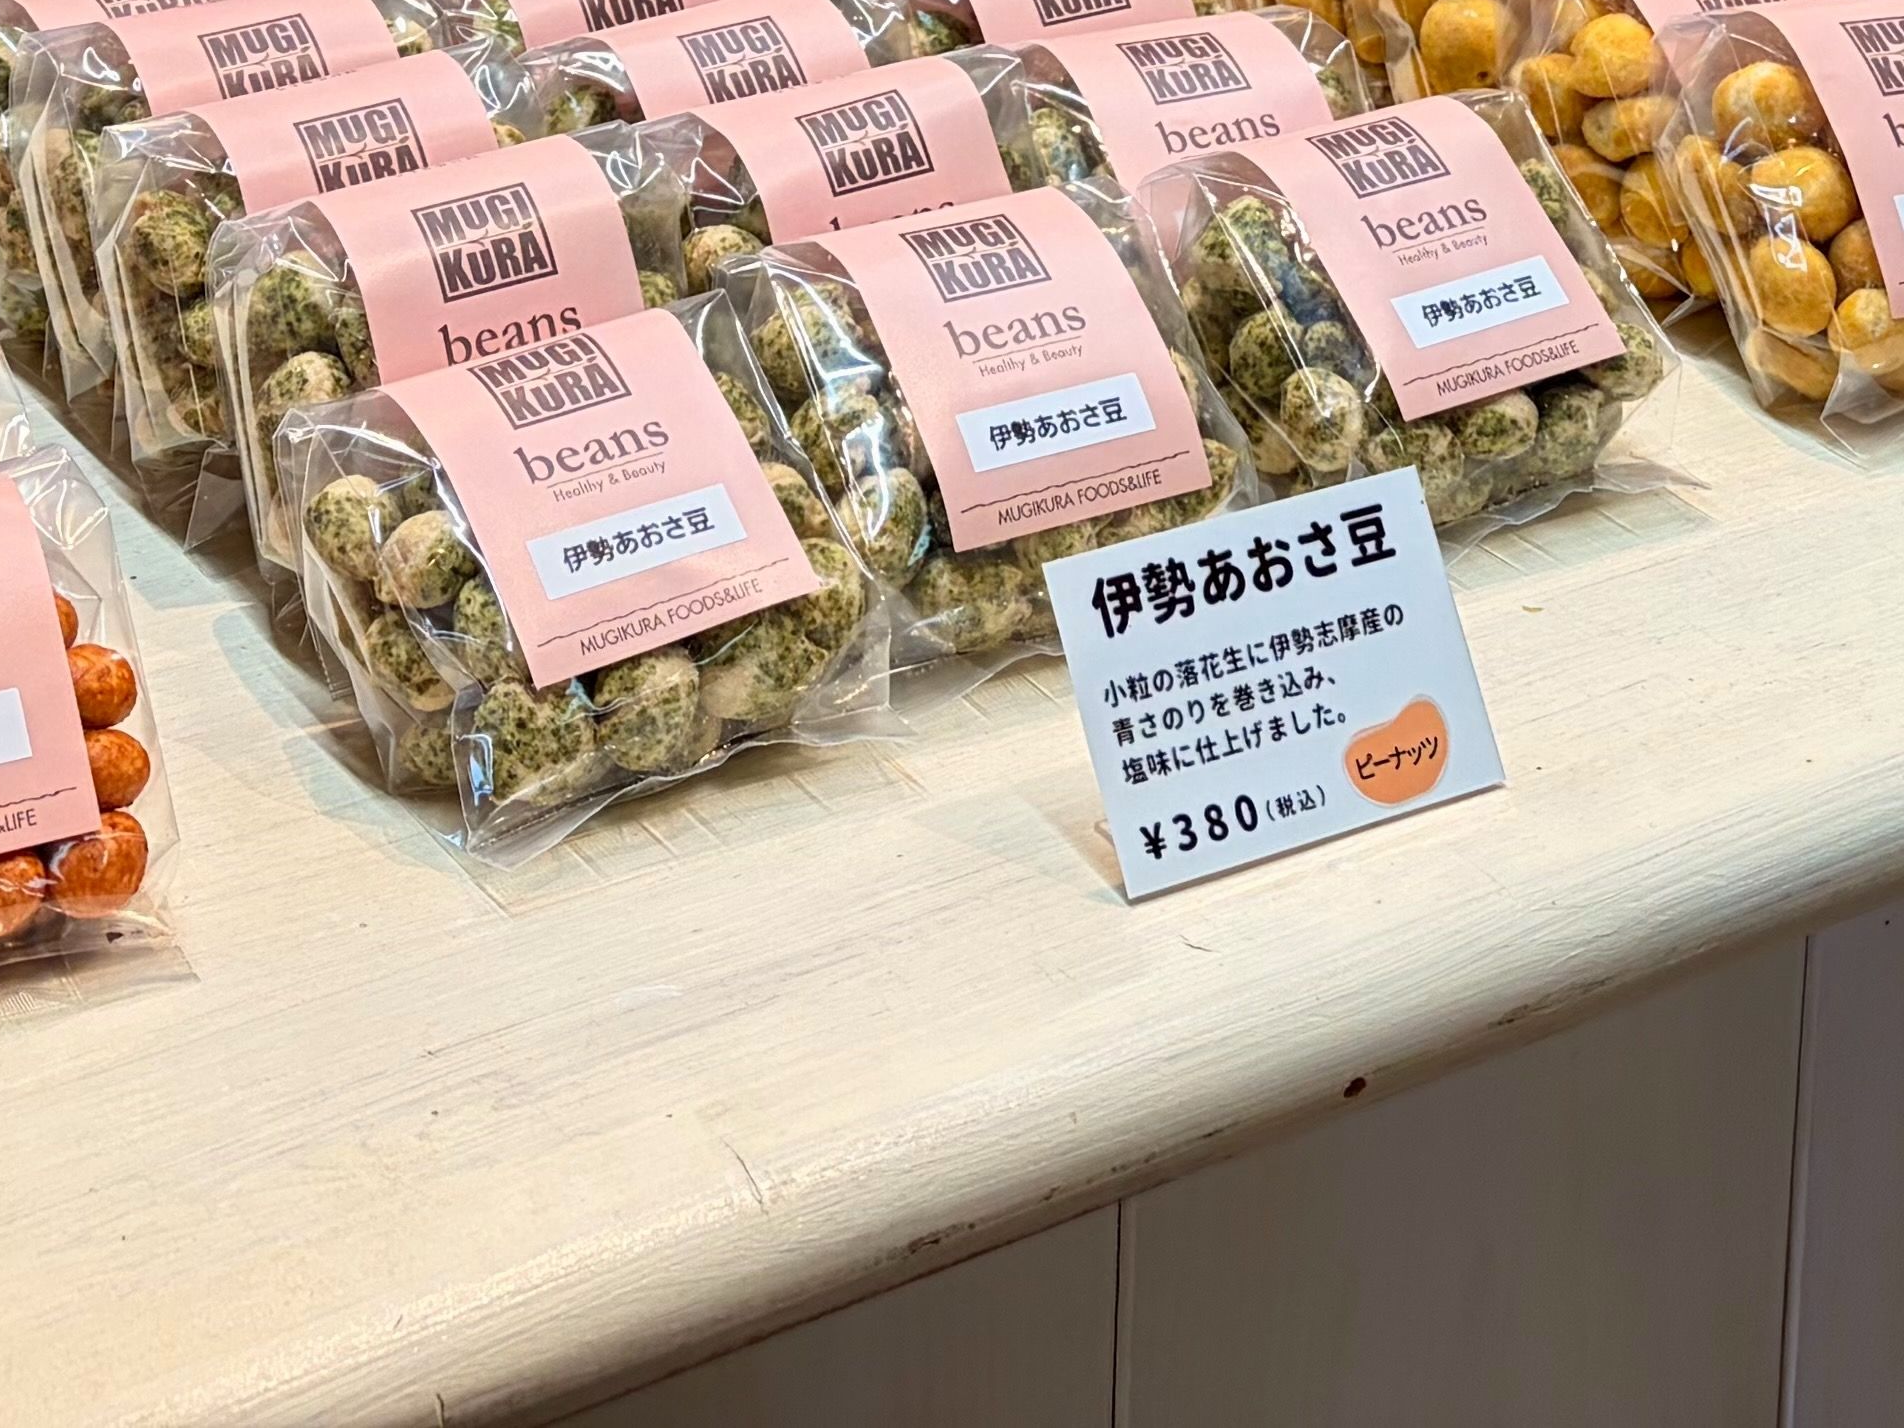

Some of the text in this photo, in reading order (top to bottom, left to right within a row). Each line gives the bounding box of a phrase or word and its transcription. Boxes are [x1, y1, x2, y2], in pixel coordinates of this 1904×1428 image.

[304, 102, 410, 156] MUGI
[1155, 111, 1281, 156] beans
[420, 188, 531, 246] MUGI
[1361, 196, 1488, 249] beans
[440, 225, 551, 298] KURA
[1422, 275, 1541, 328] 伊勢あおさ豆
[440, 305, 583, 367] beans
[943, 305, 1087, 360] beans
[979, 342, 1084, 378] Healthy & Beauty
[1436, 339, 1580, 398] MUGIKURA FOODS&LIFE
[513, 419, 670, 485] beans
[989, 398, 1127, 451] 伊勢あおさ豆
[554, 459, 667, 504] Healthy & Beauty
[998, 468, 1163, 526] MUGIKURA FOODS&LIFE
[562, 508, 715, 574] 伊勢あおさ豆
[1091, 503, 1397, 638] 伊勢あおさ豆
[580, 577, 763, 656] MUGIKURA FOODS&LIFE
[1103, 603, 1404, 708] 小粒の落花生に伊勢志摩産の
[1112, 665, 1337, 746] 青さのりを巻き込み、
[1121, 703, 1347, 786] 塩味に仕上げました。
[1355, 735, 1439, 781] ピーナッツ
[1139, 795, 1259, 860] ¥380
